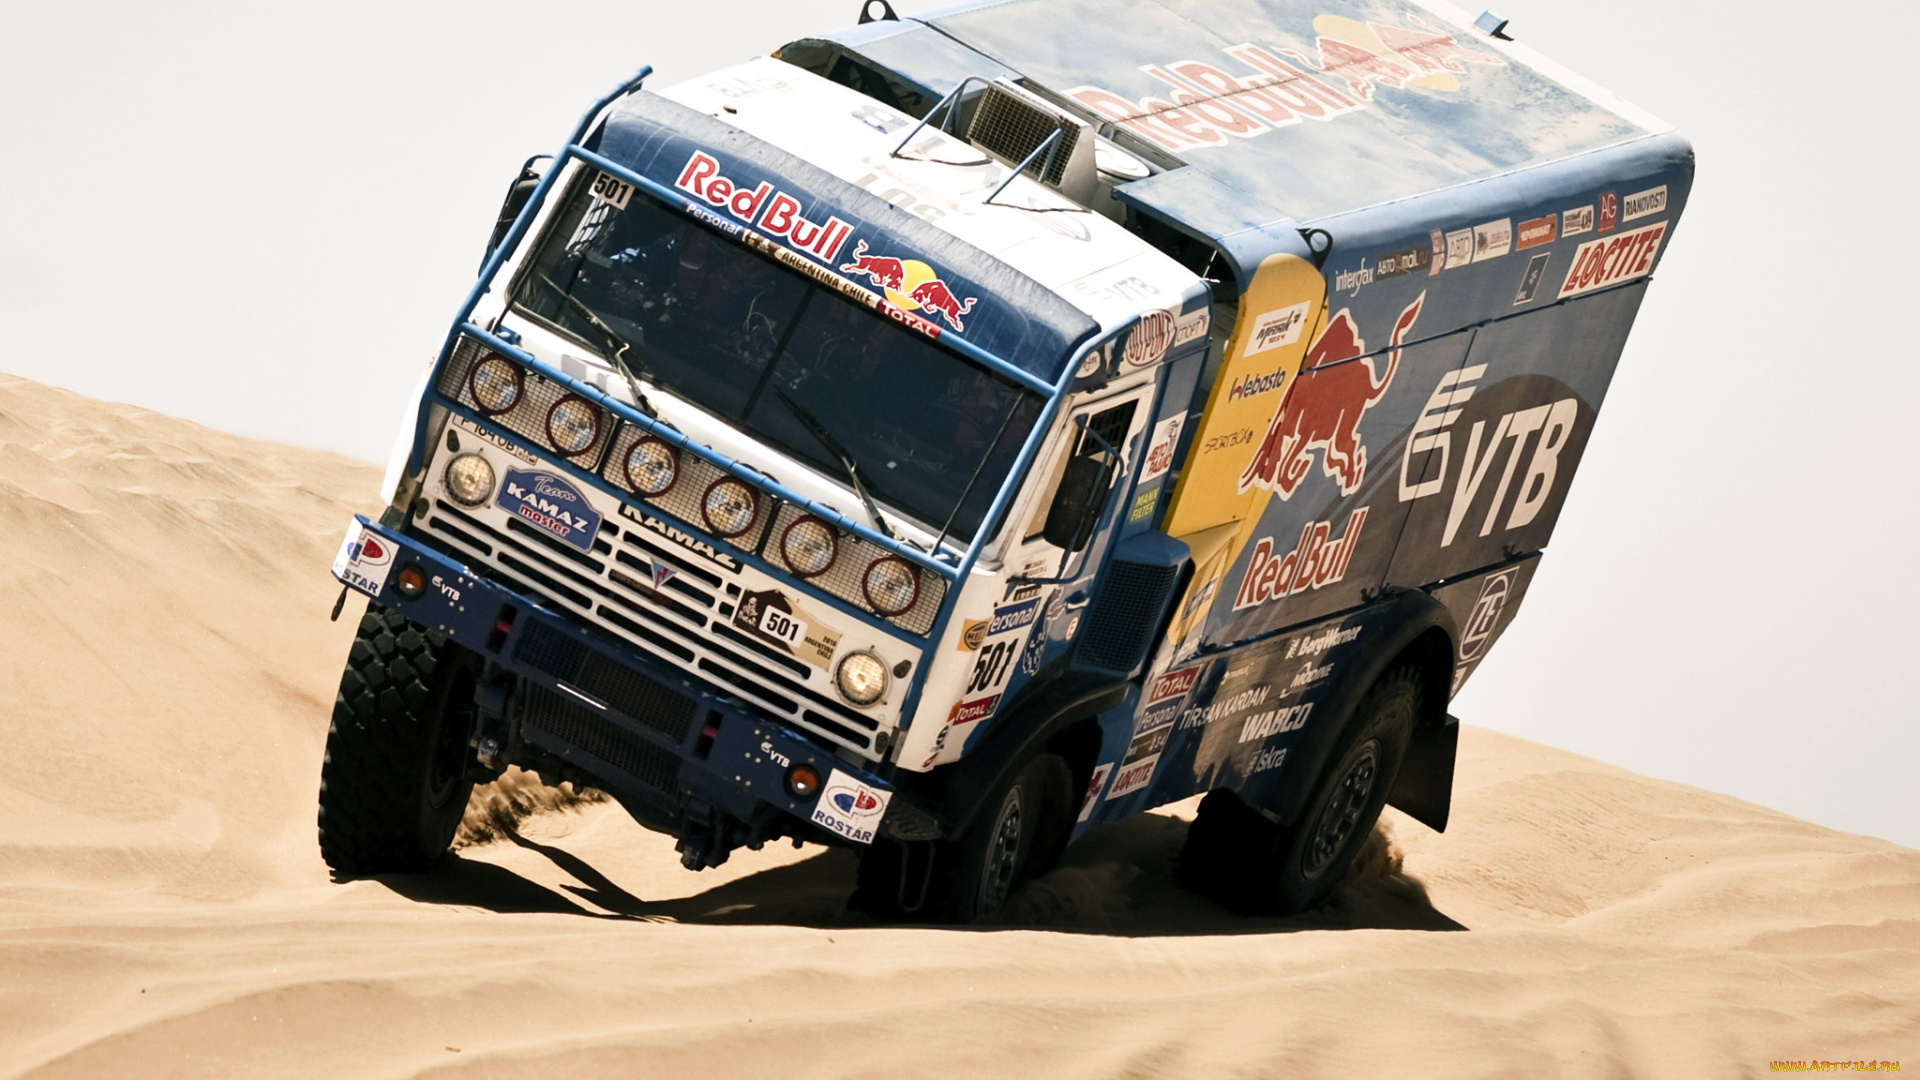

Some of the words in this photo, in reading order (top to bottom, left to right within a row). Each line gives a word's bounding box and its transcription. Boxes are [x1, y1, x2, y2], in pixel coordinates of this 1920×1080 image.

[593, 175, 628, 205] 501
[1600, 193, 1617, 220] AG
[685, 203, 743, 235] Personal
[1562, 227, 1664, 292] LOCTITE
[781, 252, 840, 289] ARGENTINA
[842, 283, 873, 306] CHILE
[1335, 257, 1374, 298] interfax
[881, 301, 936, 338] TOTAL
[1228, 366, 1286, 404] Webasto
[534, 474, 577, 503] Team
[1440, 398, 1578, 548] VTB
[506, 482, 589, 534] KAMAZ
[518, 504, 571, 537] master
[623, 504, 737, 569] KAMAZ
[334, 562, 380, 594] STAR
[441, 584, 461, 601] VTB
[766, 611, 799, 642] 501
[989, 601, 1039, 633] ersonal
[1463, 593, 1504, 644] ZF
[1297, 625, 1363, 656] BorgWarner
[966, 637, 1019, 695] 501
[1152, 674, 1190, 699] TOTAL
[1220, 685, 1272, 718] KARDAN
[955, 704, 986, 721] TOTAL
[1238, 702, 1314, 744] WABCO
[769, 750, 791, 768] VTB
[1111, 761, 1155, 793] LOCTITE
[814, 809, 873, 842] ROSTAR
